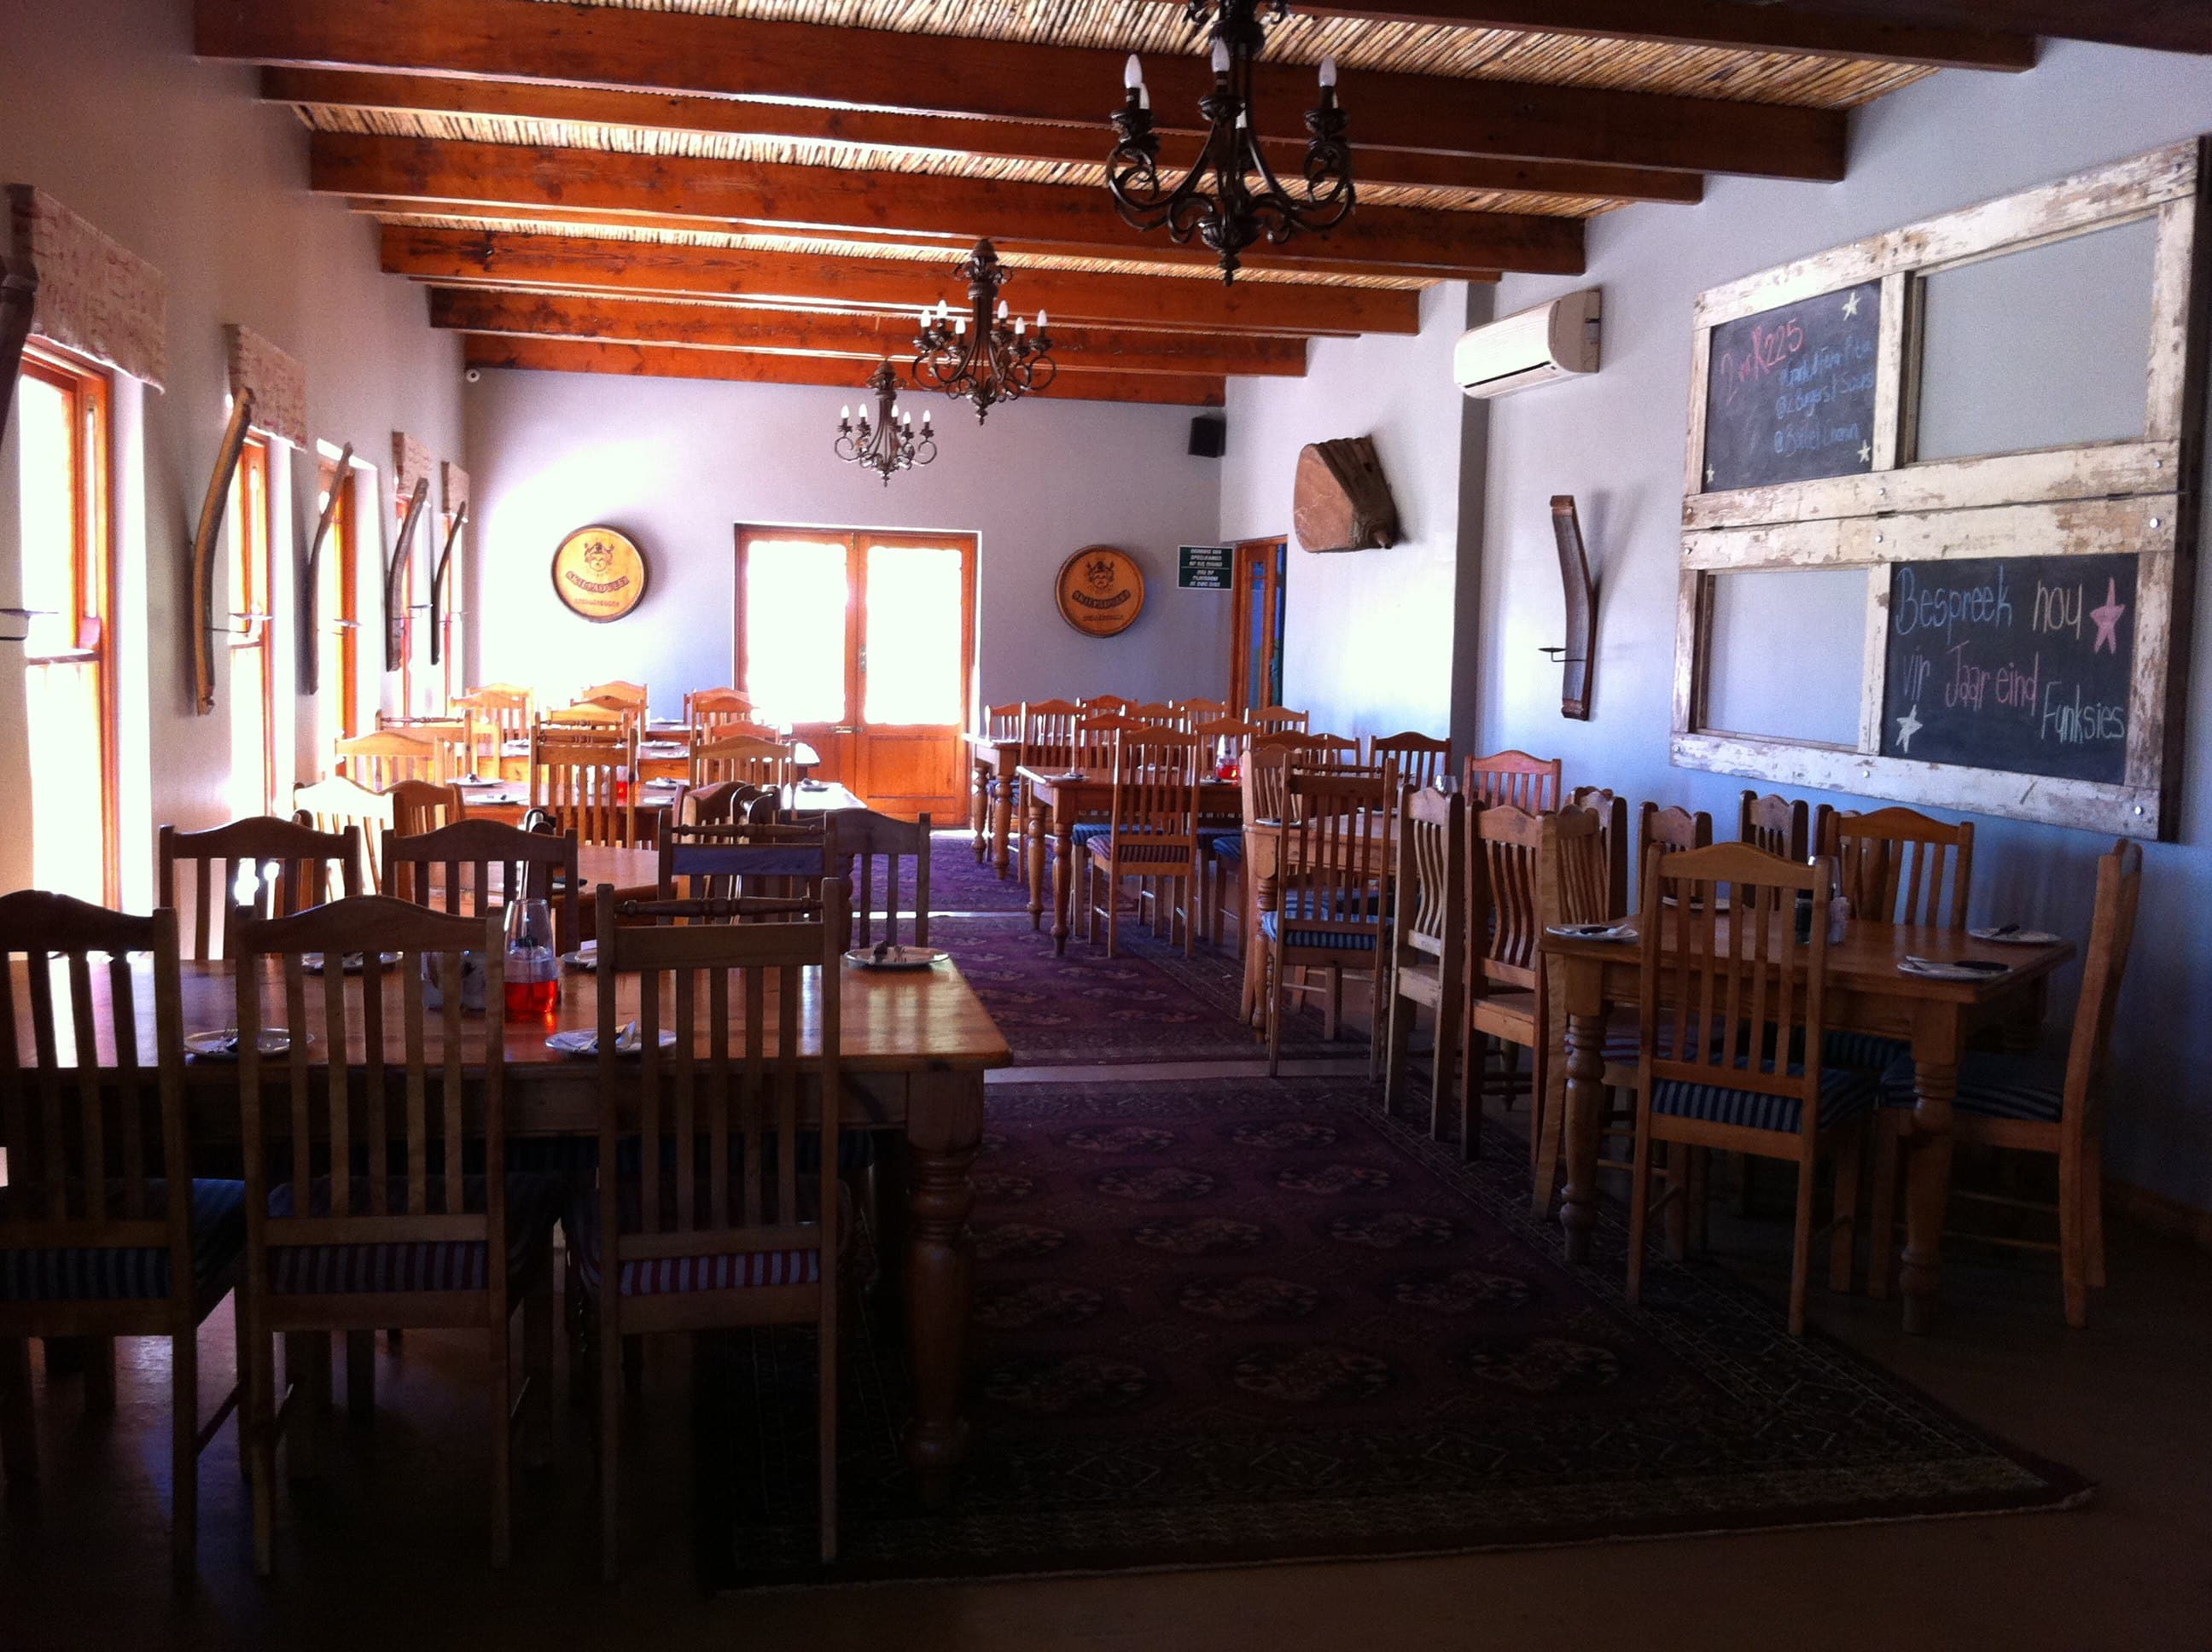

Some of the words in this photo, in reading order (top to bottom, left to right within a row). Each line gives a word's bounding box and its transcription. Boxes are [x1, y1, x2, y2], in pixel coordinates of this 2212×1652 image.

[1895, 565, 2012, 645] Bespreek
[1903, 646, 1930, 701] vir
[2040, 681, 2126, 745] Funksies
